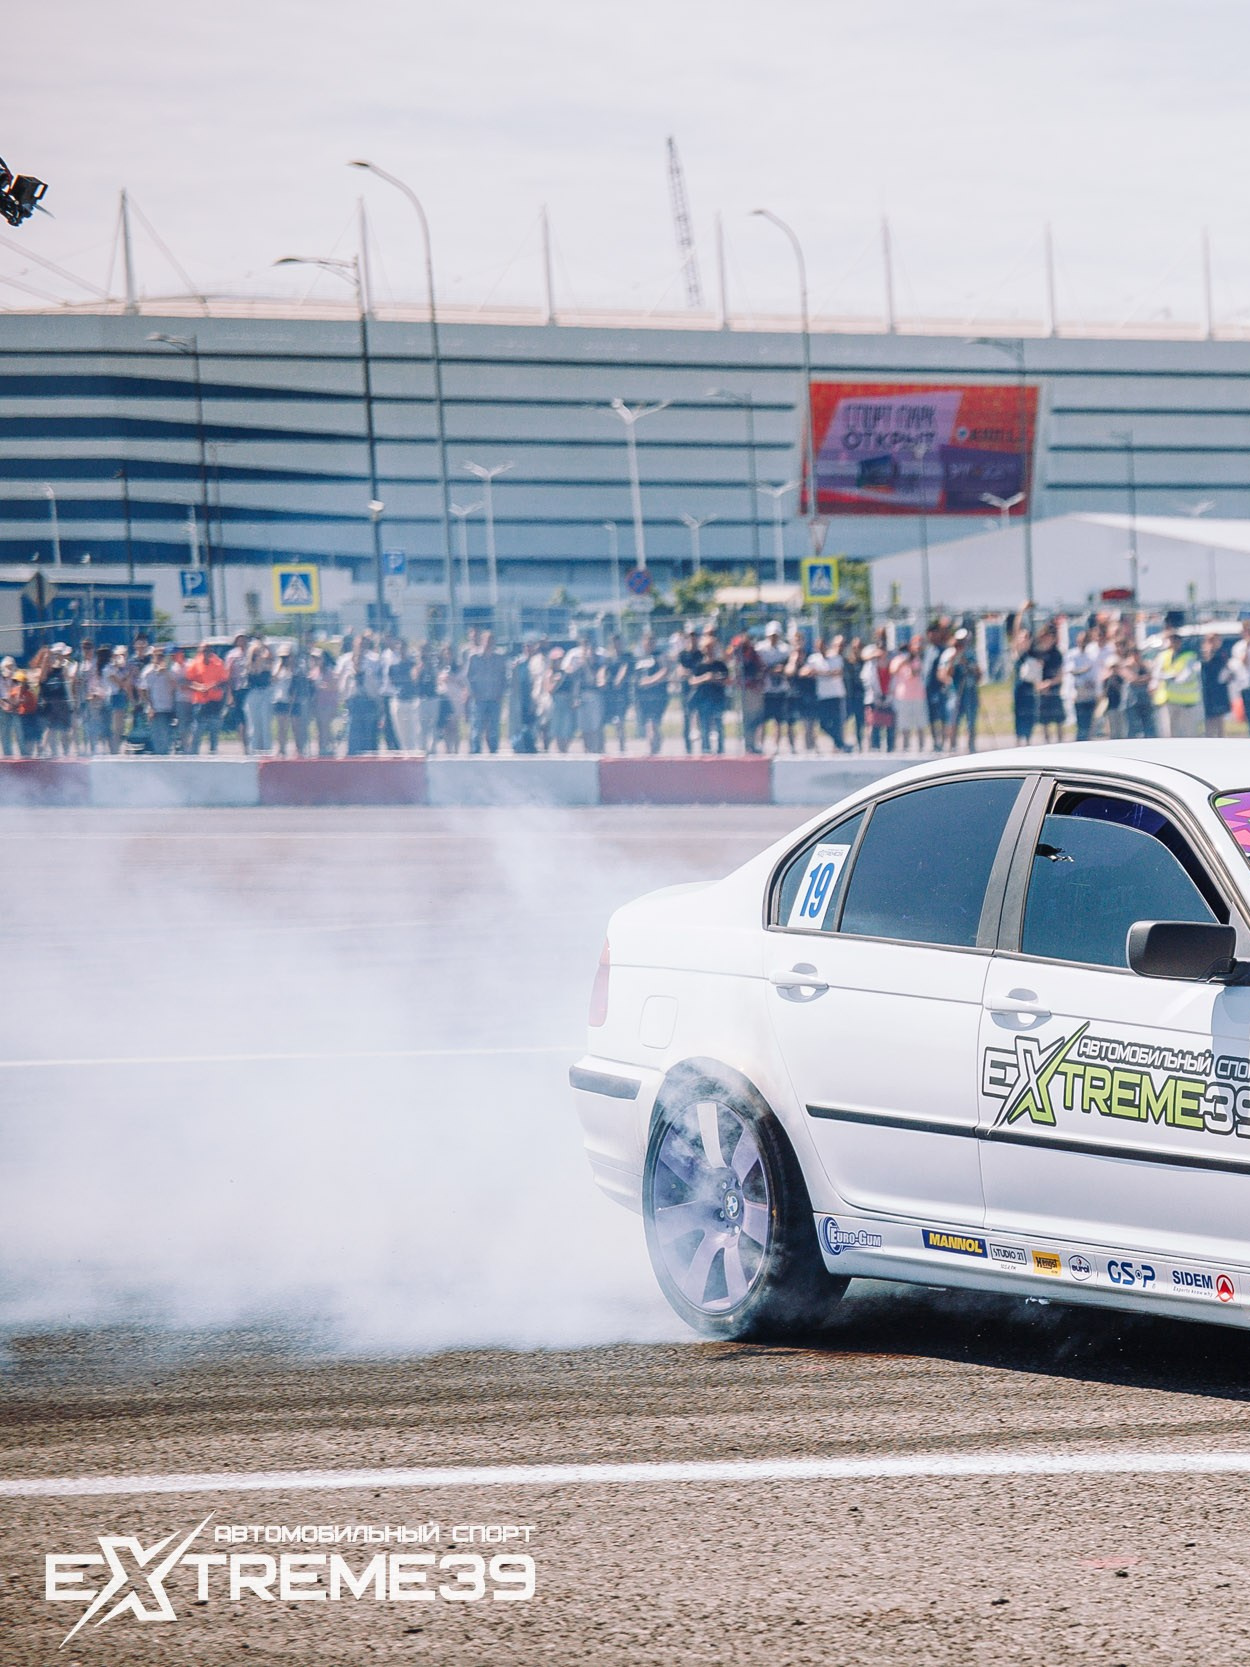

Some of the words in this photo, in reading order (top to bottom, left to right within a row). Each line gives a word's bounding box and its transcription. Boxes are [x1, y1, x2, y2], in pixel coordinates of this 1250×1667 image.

[799, 862, 836, 919] 19
[1077, 1036, 1212, 1074] АВТОМОБИЛЬНЫЙ
[929, 1232, 983, 1254] MANNOL
[993, 1248, 1016, 1259] STUDIO
[1017, 1252, 1024, 1261] 21
[1071, 1265, 1090, 1274] eurol
[1172, 1270, 1213, 1290] SIDEM
